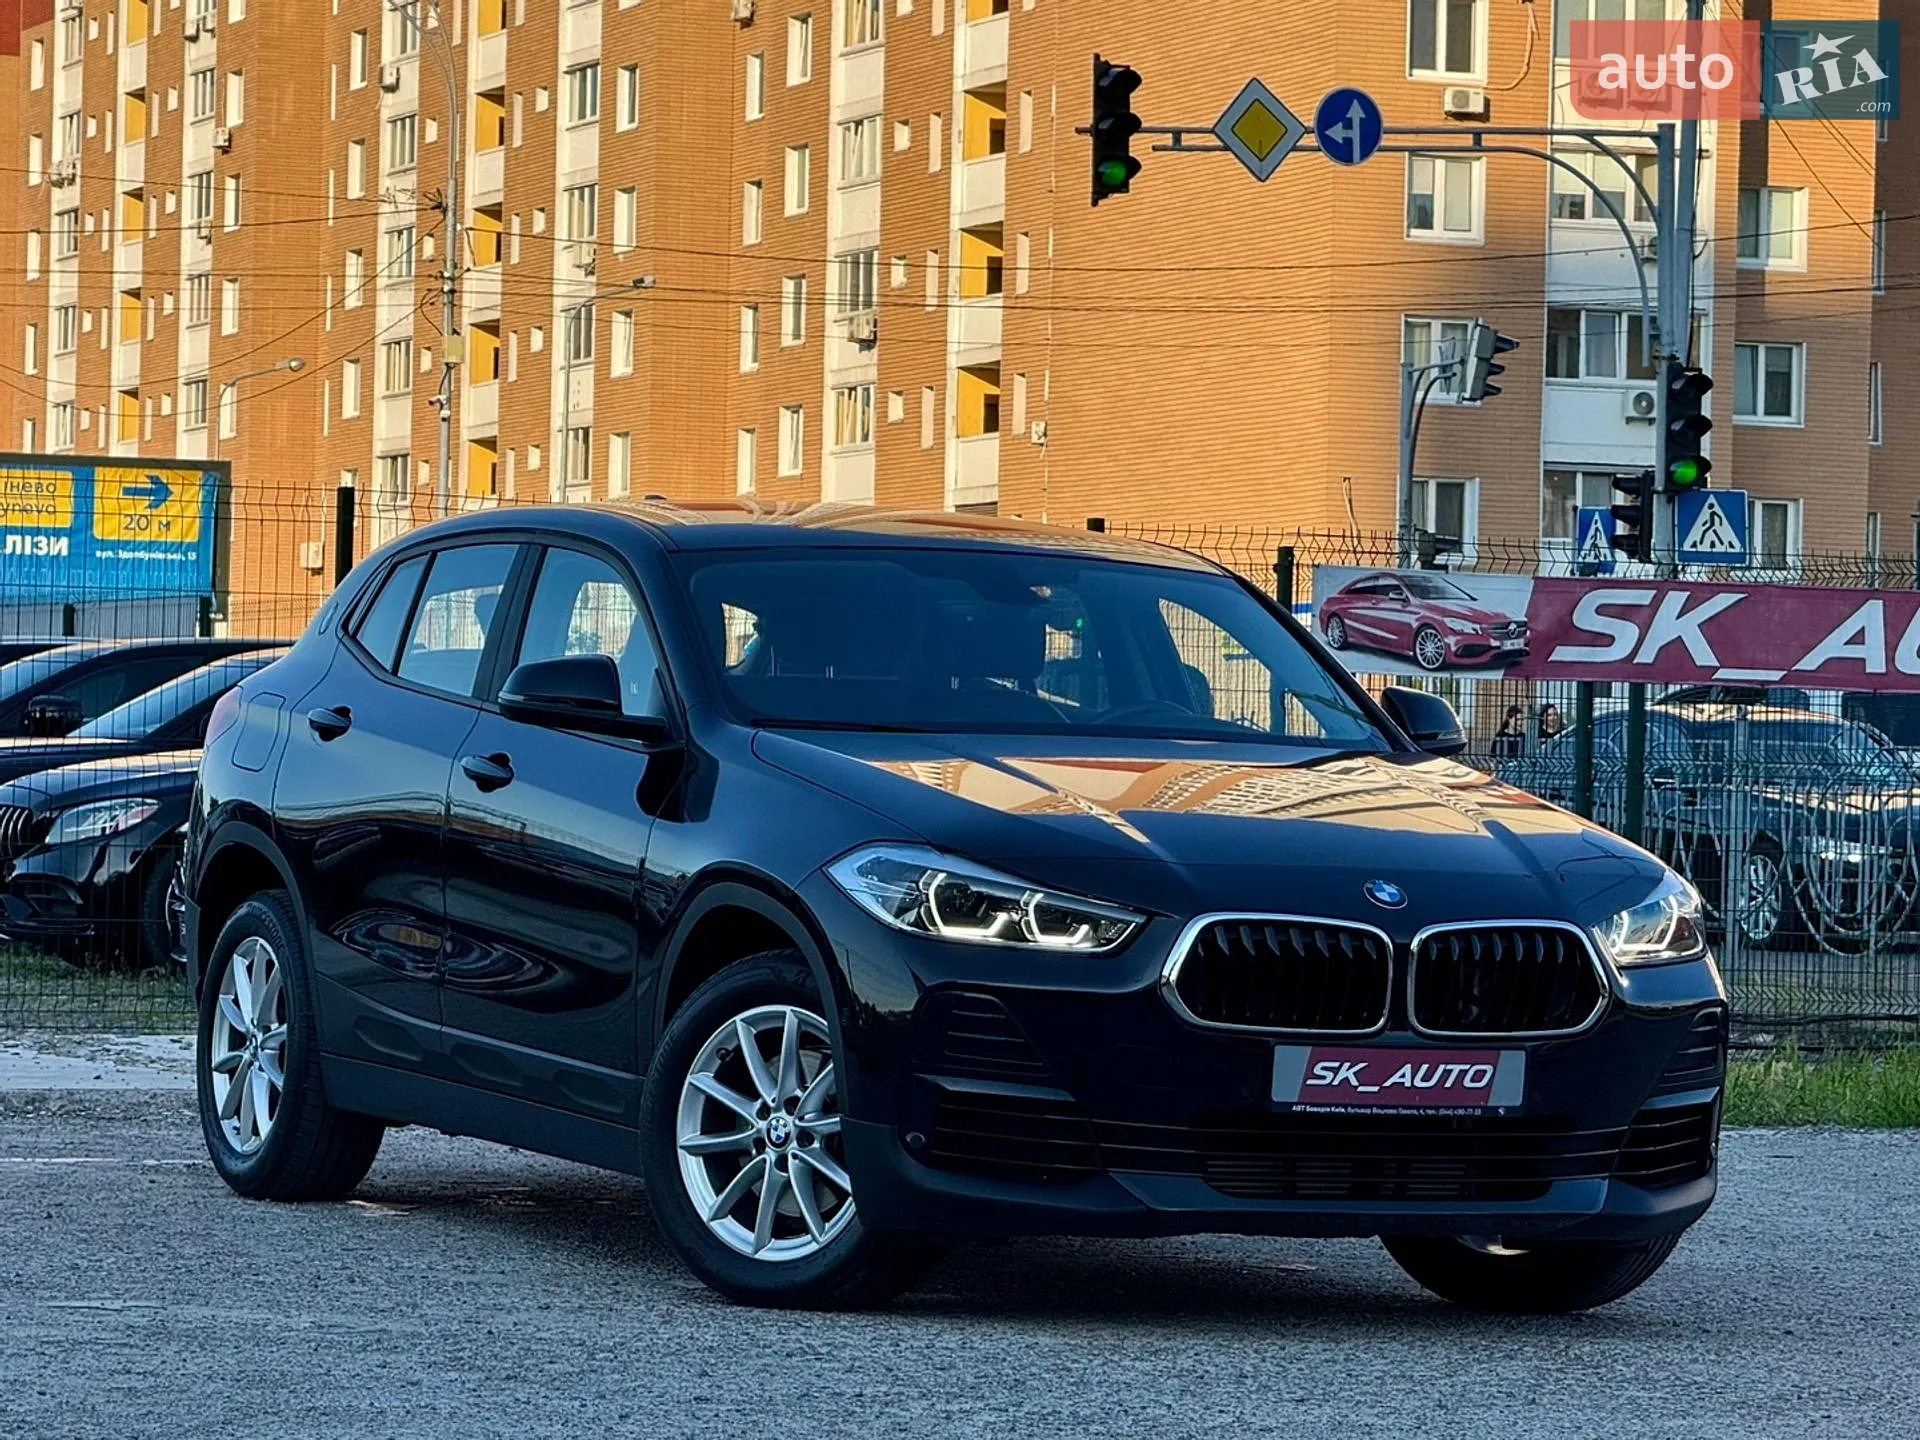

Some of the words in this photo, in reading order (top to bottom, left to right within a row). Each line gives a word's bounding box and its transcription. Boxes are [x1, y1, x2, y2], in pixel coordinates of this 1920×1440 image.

[123, 514, 150, 531] 20
[0, 534, 69, 556] ЛІЗИ
[1305, 1061, 1495, 1093] SK_AUTO
